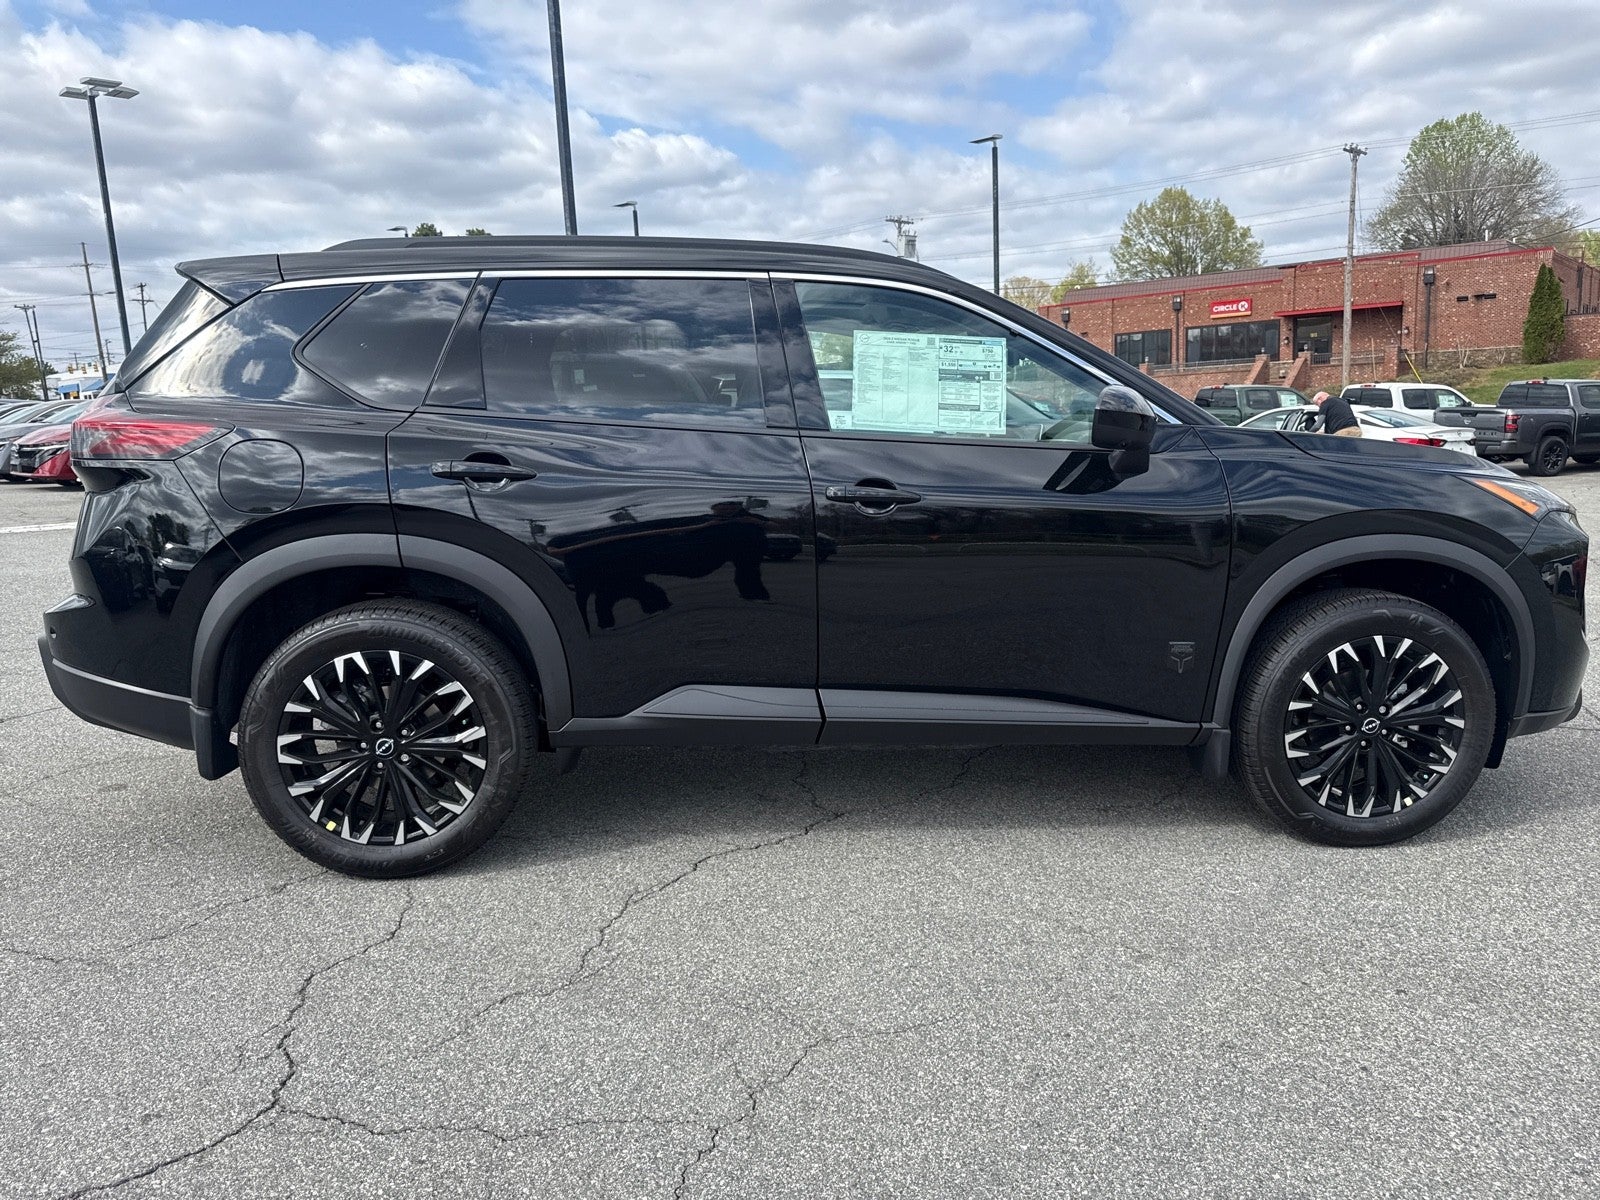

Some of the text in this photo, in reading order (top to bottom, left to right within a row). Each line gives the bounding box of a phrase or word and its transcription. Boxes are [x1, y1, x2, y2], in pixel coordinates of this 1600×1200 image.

[1213, 301, 1248, 312] CIRCLE K
[943, 345, 954, 353] 32
